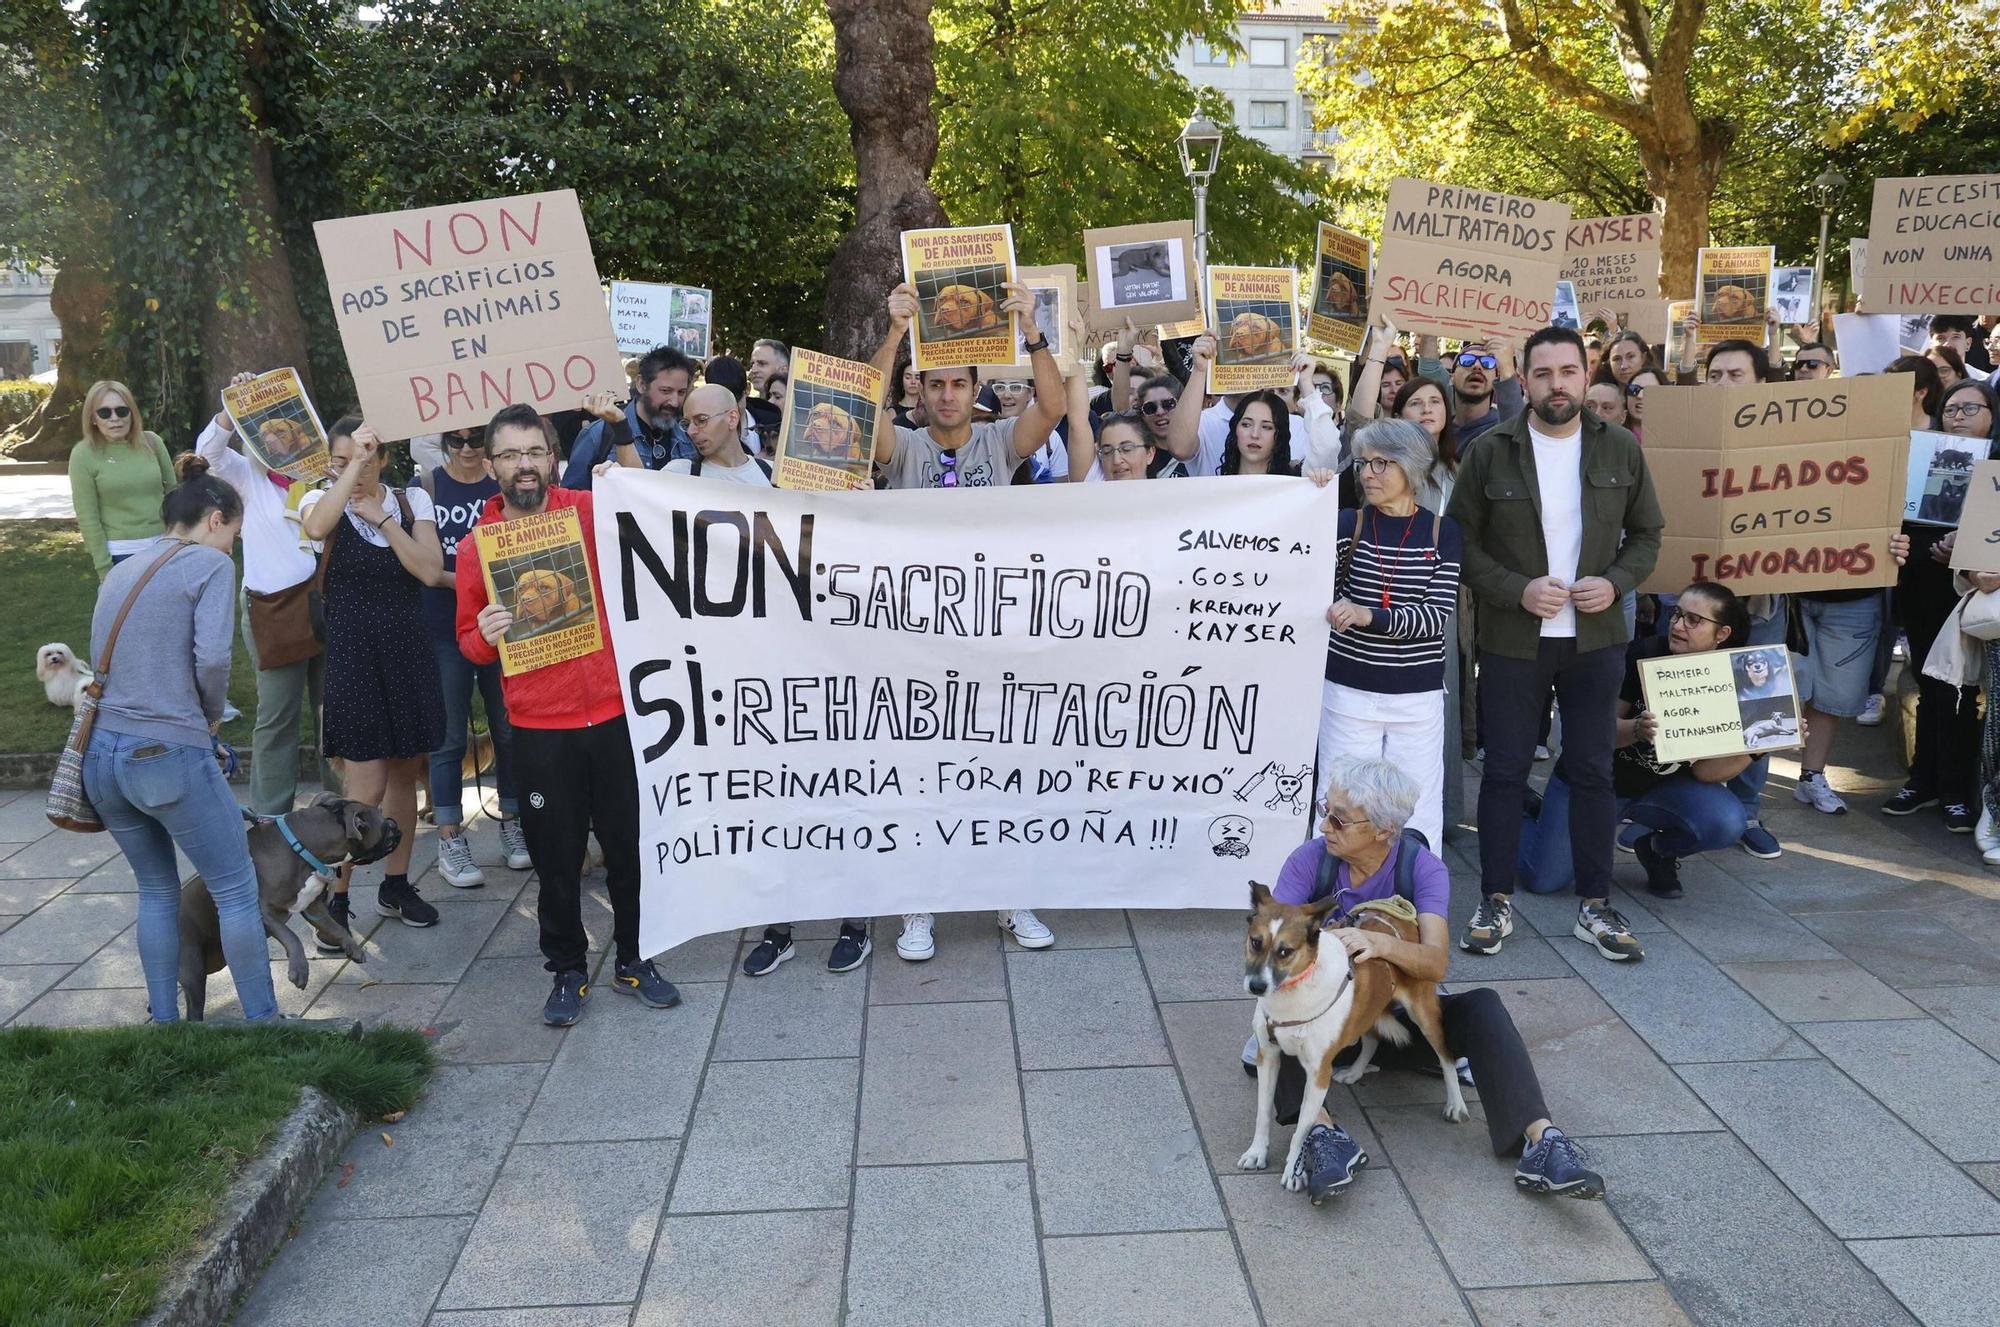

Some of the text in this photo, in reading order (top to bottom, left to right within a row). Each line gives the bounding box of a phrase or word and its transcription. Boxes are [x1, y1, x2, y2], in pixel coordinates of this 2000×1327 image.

[1427, 186, 1536, 219] PRIMEIRO
[393, 202, 541, 270] NON
[911, 232, 1004, 249] NON AOS SACRIFICIOS
[1392, 210, 1556, 251] MALTRATADOS
[1565, 217, 1654, 251] KAYSER
[921, 261, 932, 269] NO
[932, 259, 961, 268] REFUXIO
[973, 256, 997, 264] BANDO
[924, 243, 993, 260] DE ANIMAIS
[1328, 239, 1336, 250] DE
[1337, 242, 1361, 260] ANIMAIS
[1572, 253, 1637, 269] 10 MESES
[1883, 247, 1925, 265] NON
[1943, 245, 1992, 262] UNHA
[1214, 272, 1290, 283] NON AOS SACRIFICIOS
[1437, 258, 1512, 287] AGORA
[1712, 260, 1761, 268] DE ANIMAIS
[343, 260, 555, 315] AOS SACRIFICIOS
[616, 296, 647, 305] VOTAN
[1225, 282, 1280, 294] DE ANIMAIS
[1383, 275, 1552, 323] SACRIFICADOS
[382, 289, 561, 343] DE ANIMAIS
[617, 309, 650, 319] MATAR
[618, 323, 636, 331] SEN
[452, 334, 487, 360] EN
[616, 336, 652, 346] VALORAR
[920, 348, 956, 357] PRECISAN
[942, 340, 975, 348] KRENCHY
[797, 349, 882, 382] NON AOS SACRIFICIOS
[925, 354, 954, 362] ALAMEDA
[410, 355, 596, 422] BANDO
[807, 362, 872, 390] DE ANIMAIS
[813, 376, 842, 388] REFUXIO
[842, 383, 851, 391] DE
[236, 396, 250, 409] DE
[250, 382, 288, 404] ANIMAIS
[1734, 394, 1848, 429] GATOS
[782, 466, 817, 481] PRECISAN
[825, 476, 845, 488] NOSO
[804, 463, 838, 478] KRENCHY
[1701, 455, 1869, 499] ILLADOS
[434, 499, 487, 530] DOX
[481, 507, 575, 538] NON AOS SACRIFICIOS
[1730, 506, 1833, 534] GATOS
[495, 550, 506, 558] NO
[507, 544, 536, 556] REFUXIO
[547, 535, 571, 546] BANDO
[496, 521, 567, 549] DE ANIMAIS
[1177, 528, 1311, 555] SALVEMOS A:
[616, 509, 1151, 639] NON: SACRIFICIO
[1691, 542, 1875, 584] IGNORADOS
[506, 623, 596, 653] GOSU, KRENCHY E KAYSER
[508, 646, 545, 661] PRECISAN
[552, 638, 572, 649] NOSO
[573, 631, 595, 644] APOIO
[513, 656, 544, 667] ALAMEDA
[554, 640, 595, 656] COMPOSTELA
[1656, 667, 1711, 681] PRIMEIRO
[1659, 682, 1734, 699] MALTRATADOS
[734, 665, 1259, 755] REHABILITACIÓN
[1663, 706, 1700, 718] AGORA
[1665, 720, 1742, 740] EUTANASIADOS
[652, 759, 903, 816] VETERINARIA
[937, 756, 1022, 794] FÓRA
[1036, 769, 1072, 796] DO
[656, 819, 900, 875] POLITICUCHOS
